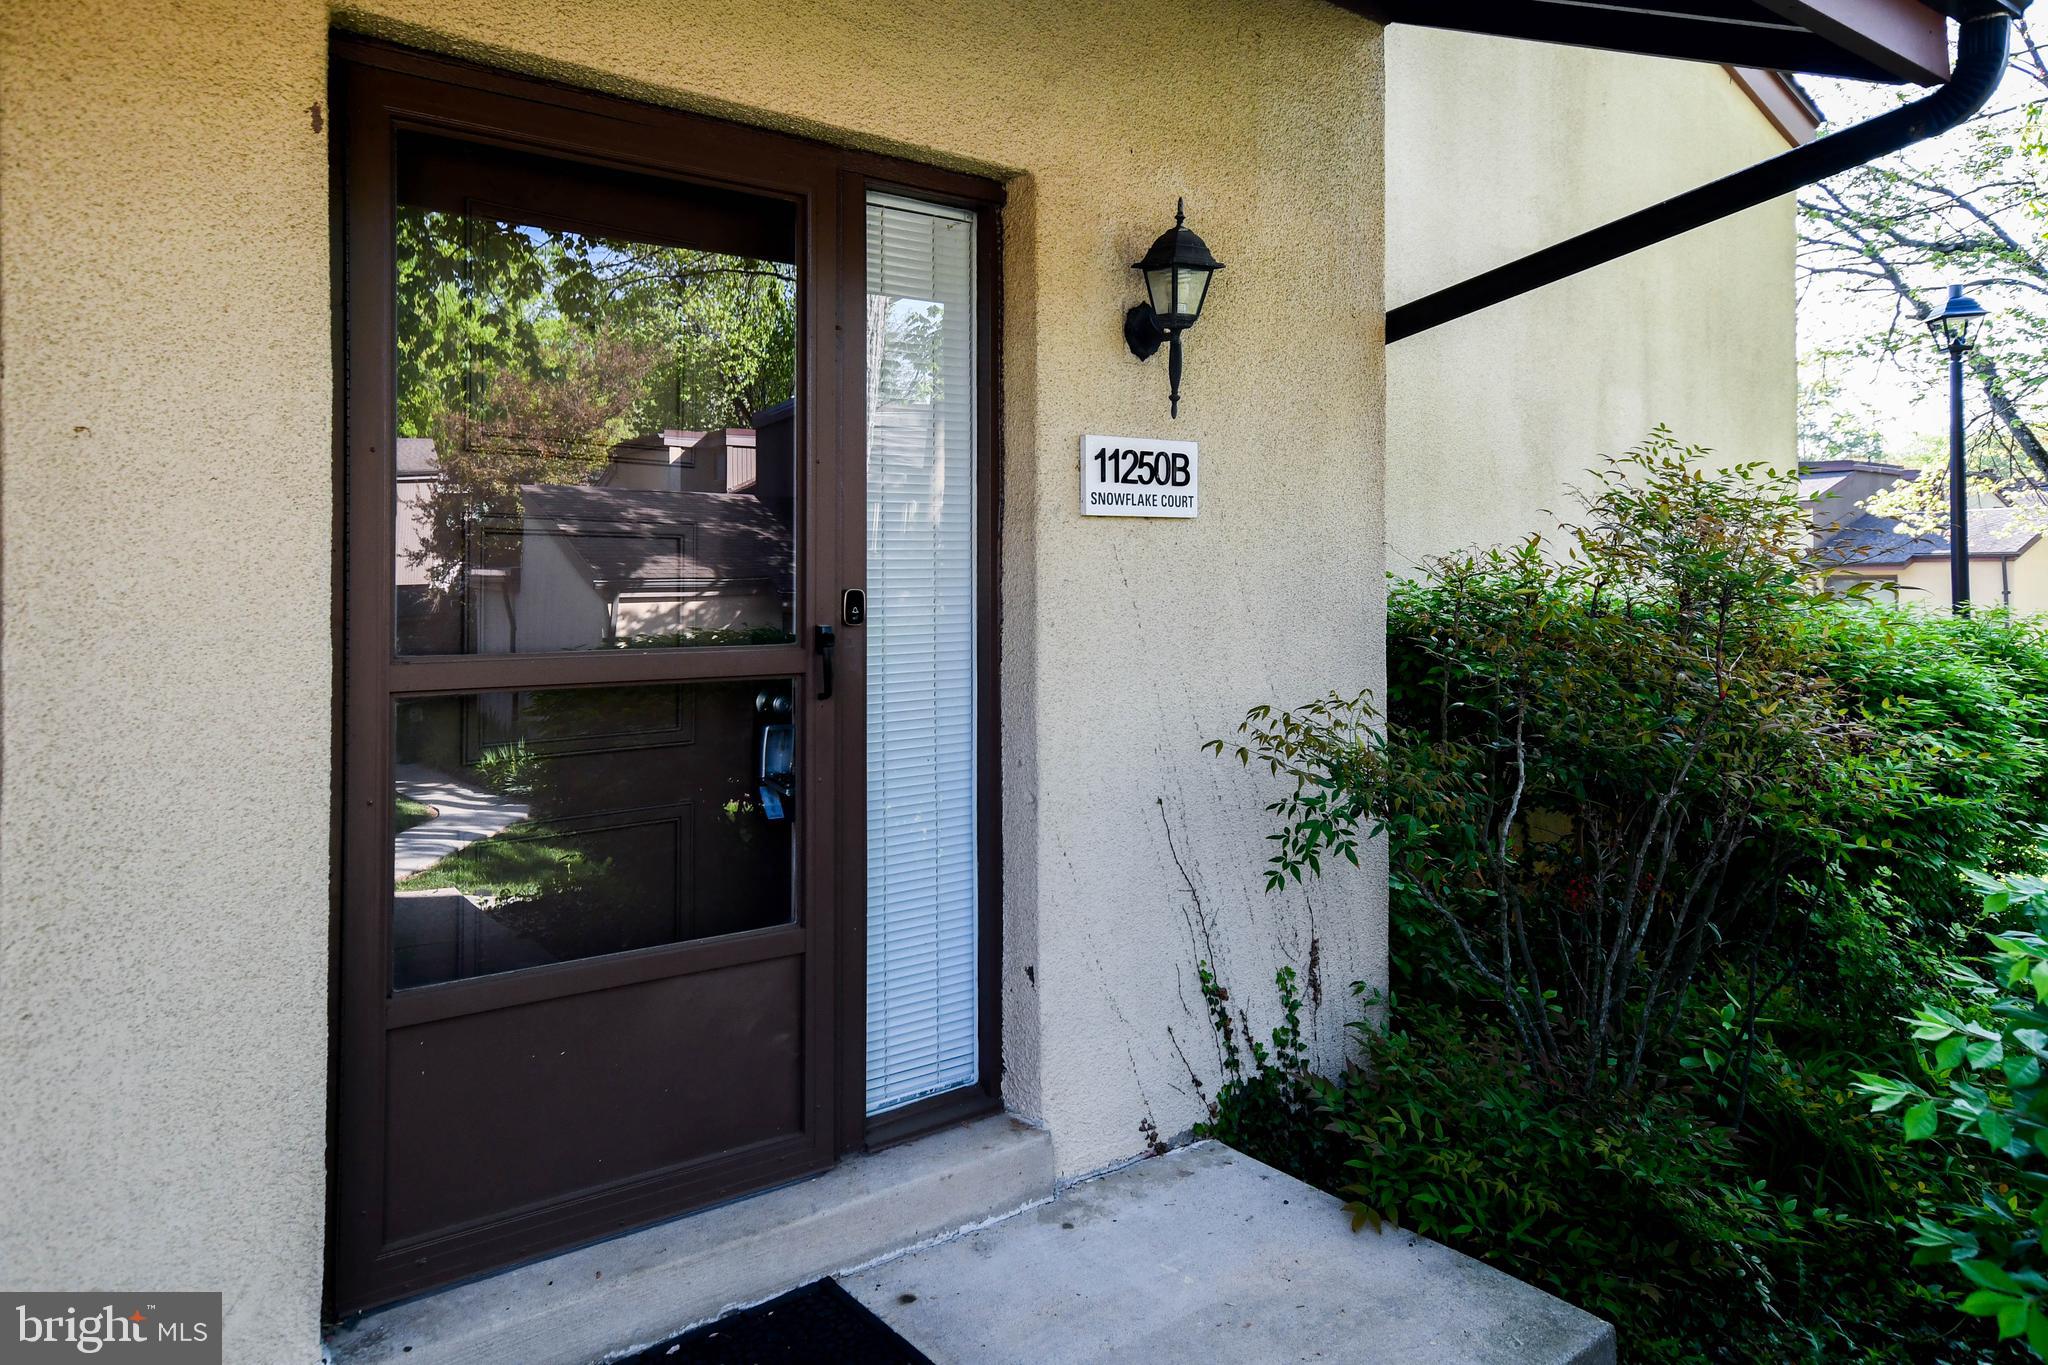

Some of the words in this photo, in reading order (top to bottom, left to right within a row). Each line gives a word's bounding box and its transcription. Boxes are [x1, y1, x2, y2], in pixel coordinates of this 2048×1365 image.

[1094, 447, 1191, 486] 11250B
[1090, 491, 1158, 507] SNOWFLAKE
[1161, 494, 1195, 508] COURT
